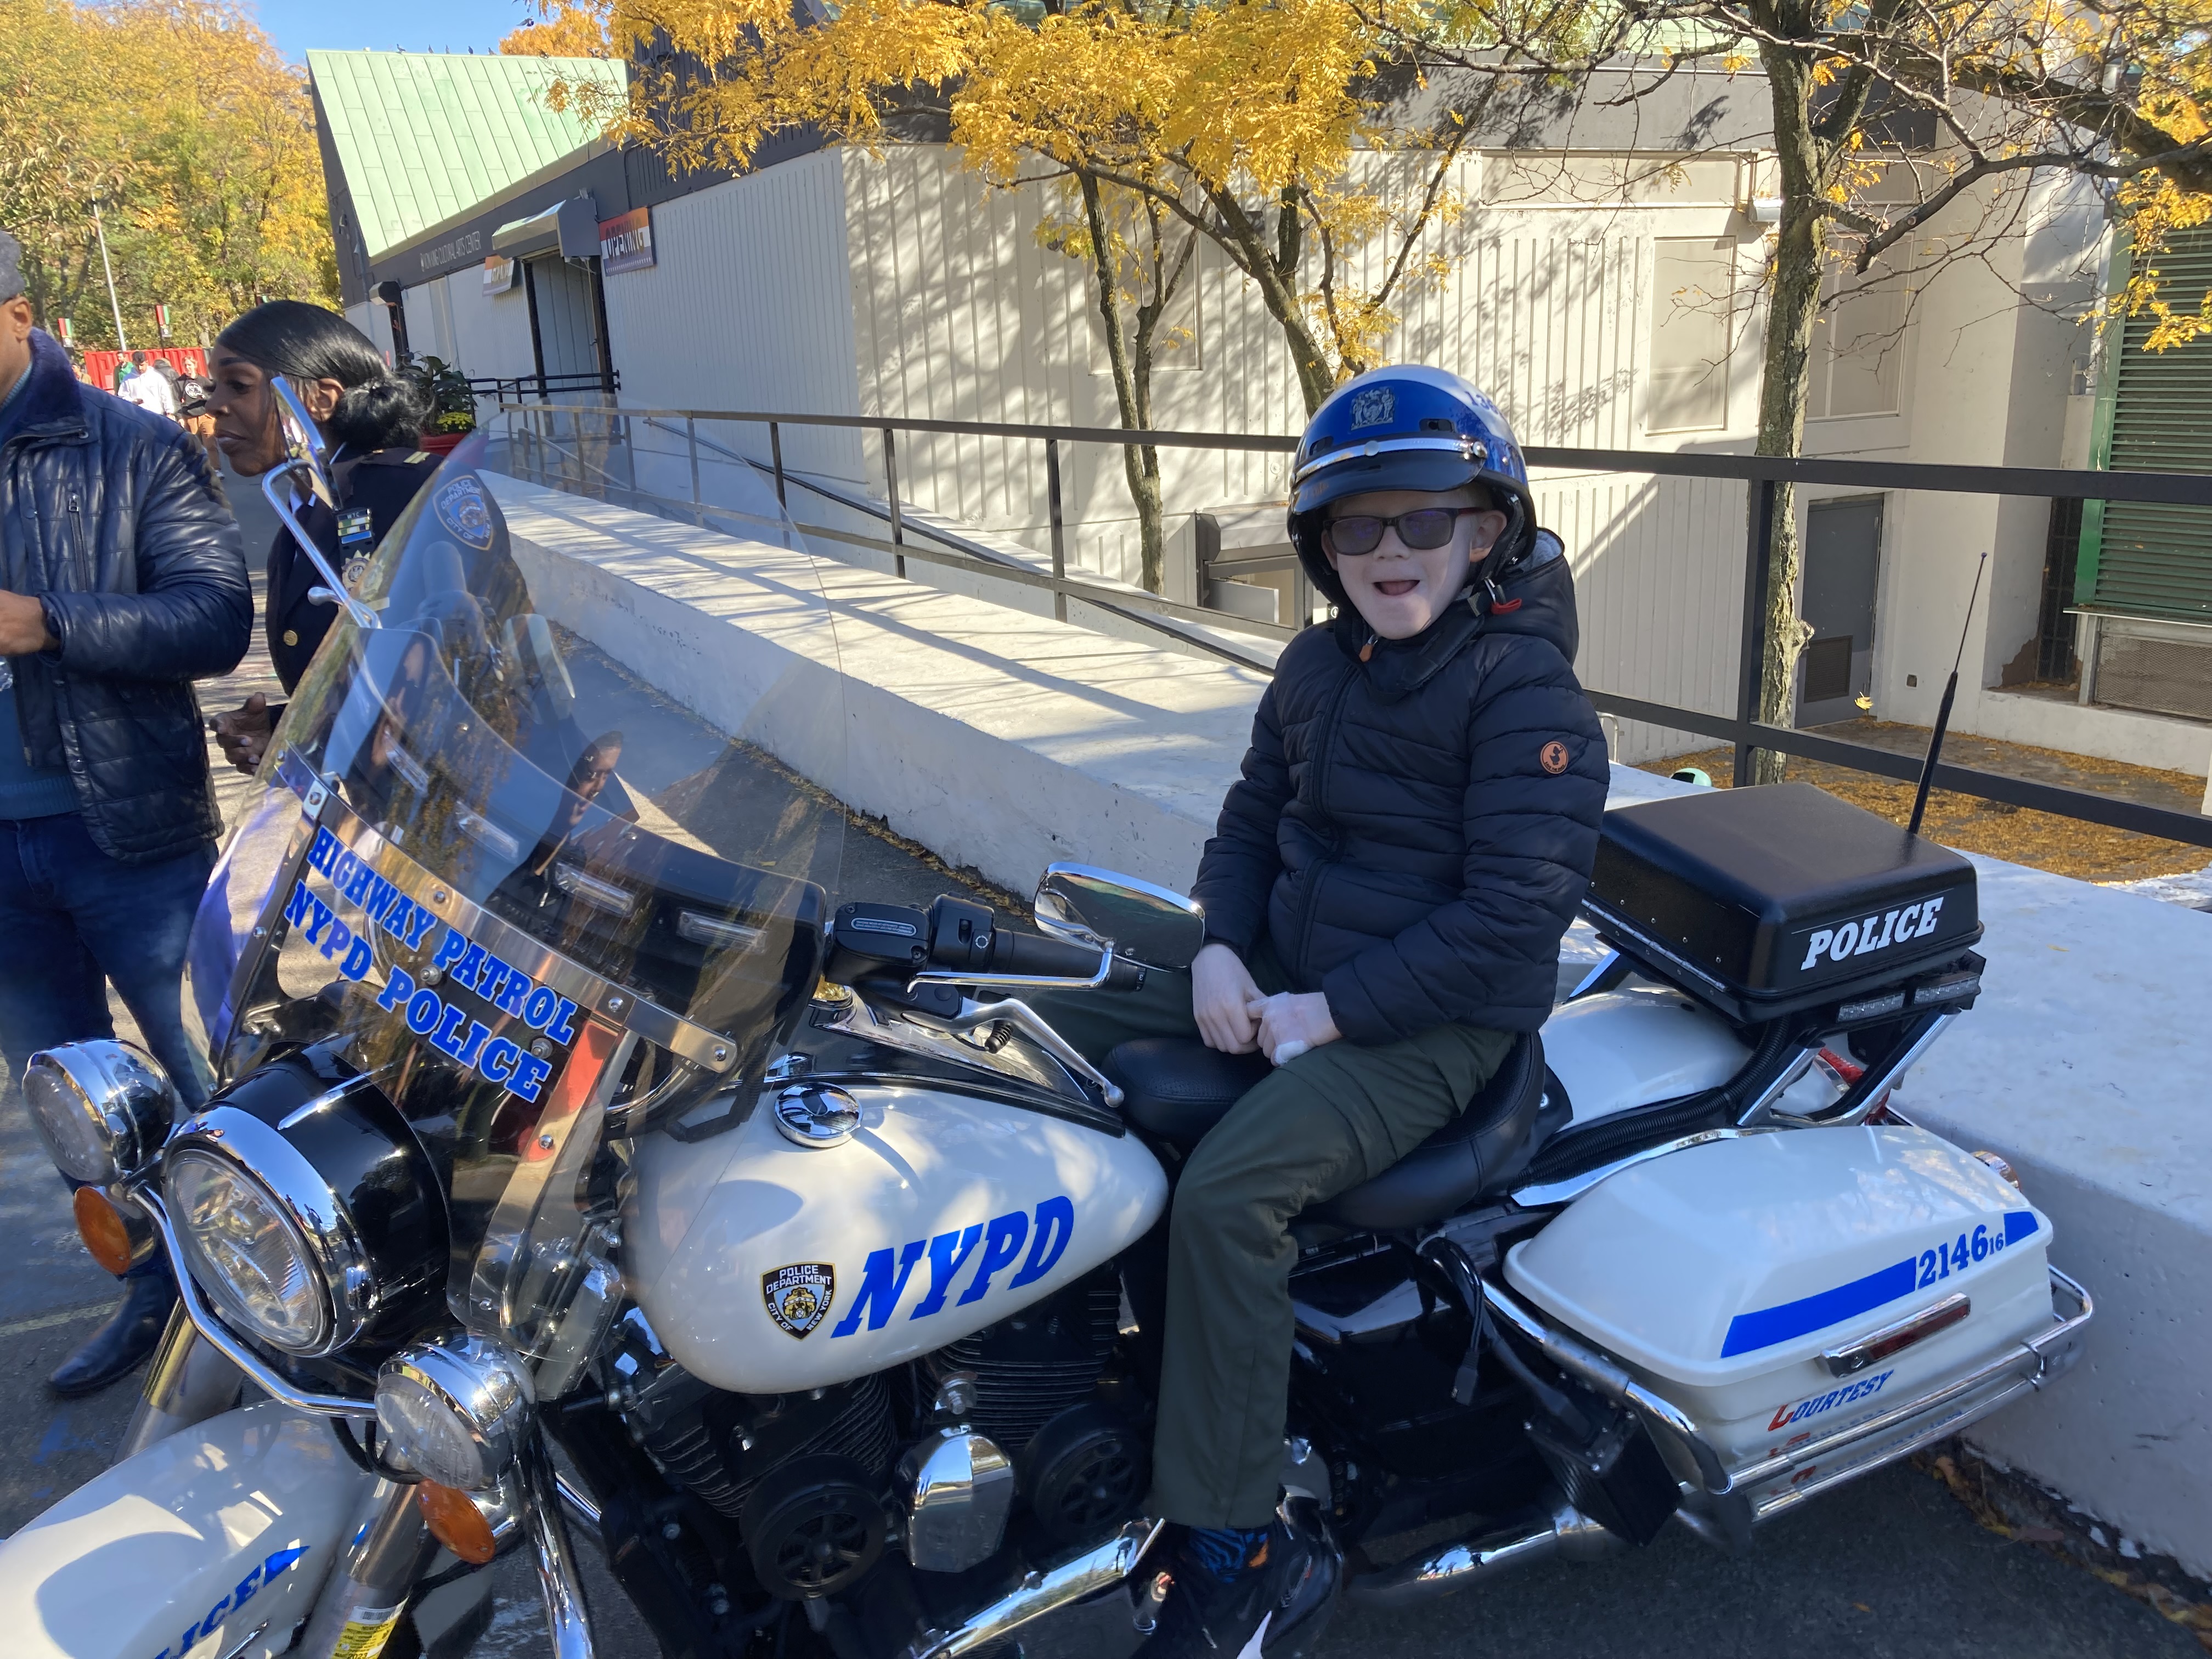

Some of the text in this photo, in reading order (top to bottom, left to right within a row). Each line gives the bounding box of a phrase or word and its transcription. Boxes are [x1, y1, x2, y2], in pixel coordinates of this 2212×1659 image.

[456, 237, 466, 257] ARTS
[465, 230, 481, 255] CENTER
[606, 216, 645, 263] OPENING
[307, 825, 578, 1046] HIGHWAY PATROL
[1801, 896, 1944, 970] POLICE
[284, 879, 552, 1103] NYPD POLICE
[779, 1265, 819, 1280] POLICE
[830, 1196, 1074, 1338] NYPD
[1918, 1224, 1988, 1289] 2146
[766, 1274, 832, 1295] DEPARTMENT
[768, 1302, 793, 1331] CITY OF
[806, 1289, 832, 1330] NEW YORK
